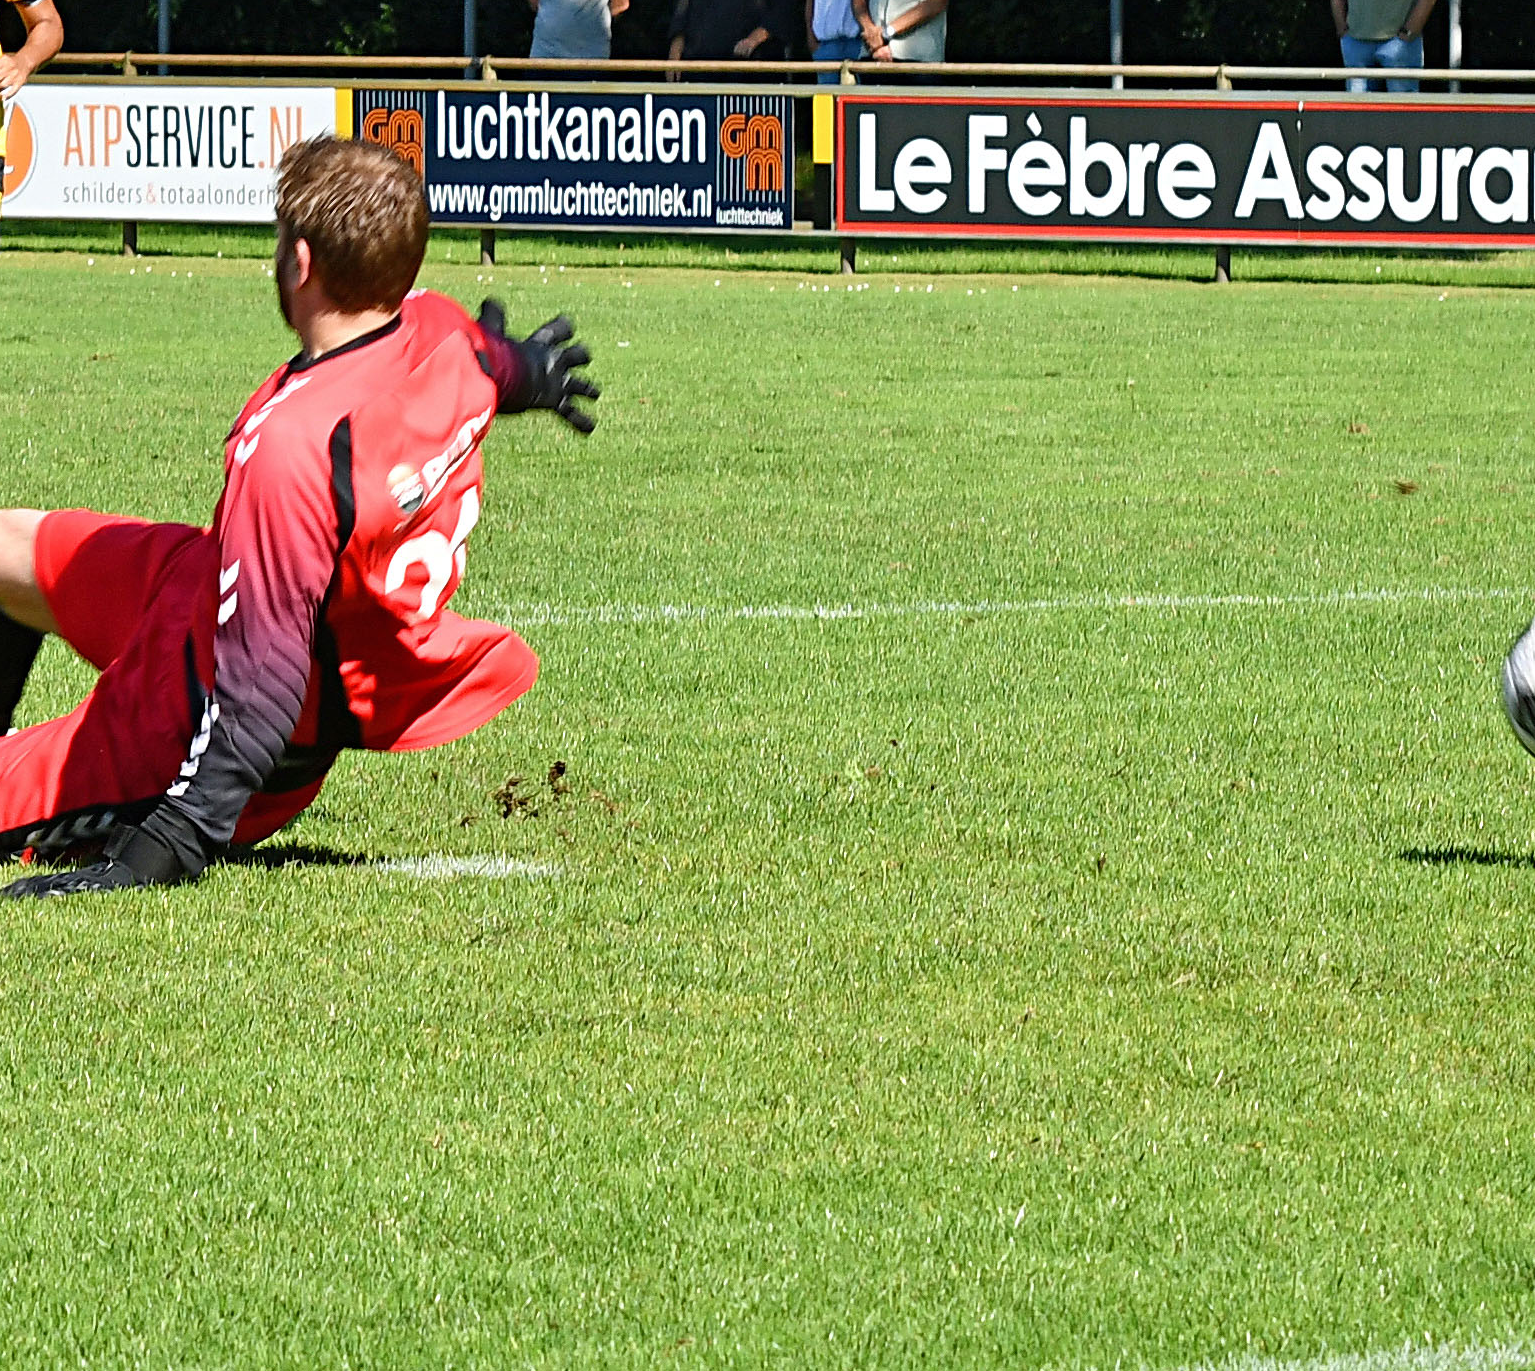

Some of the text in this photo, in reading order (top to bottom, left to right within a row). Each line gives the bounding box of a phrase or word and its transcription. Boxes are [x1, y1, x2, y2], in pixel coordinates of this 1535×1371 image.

[437, 90, 706, 163] luchtkanalen
[859, 113, 953, 214] Le
[968, 112, 1217, 219] Fèbre
[429, 180, 712, 221] www.gmmluchttechniek.nl
[716, 206, 784, 226] luchttechniek
